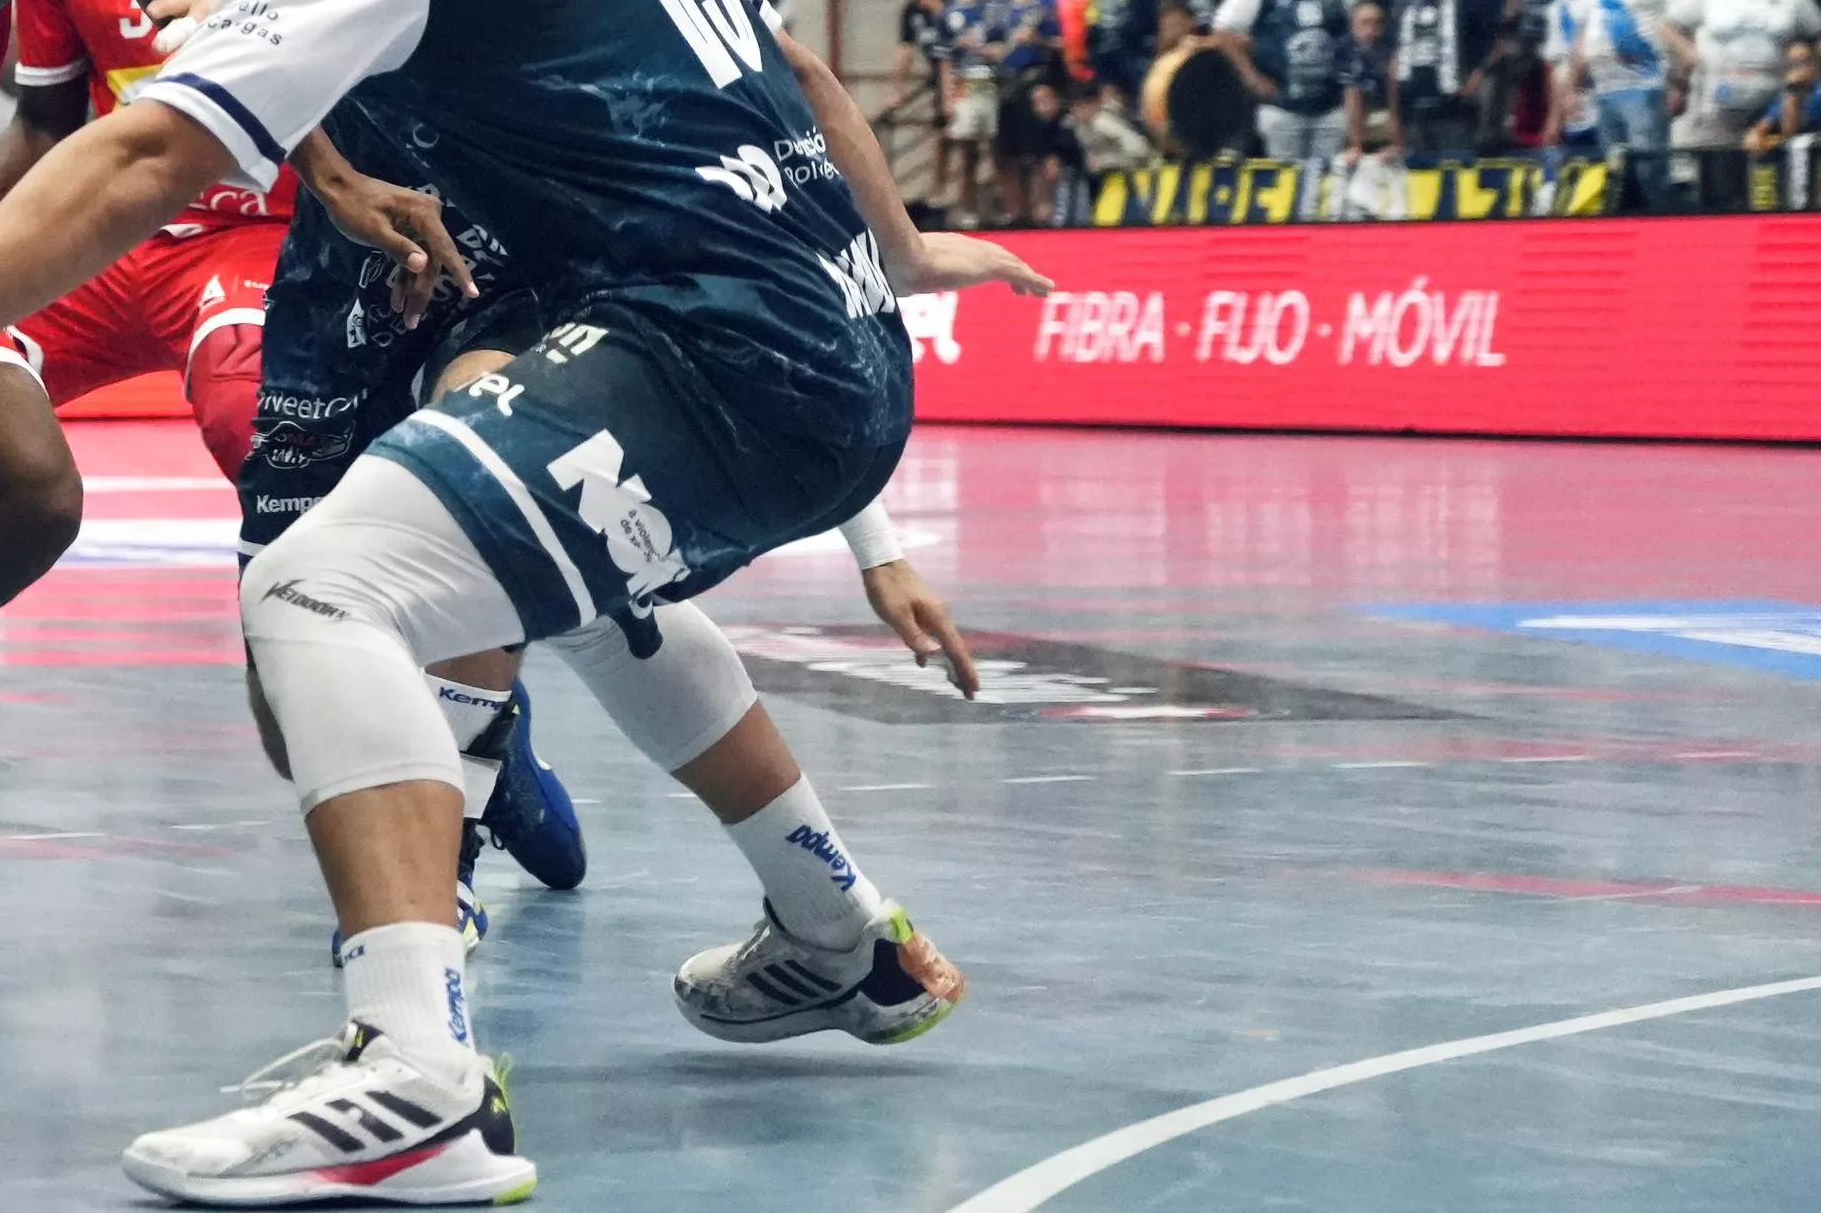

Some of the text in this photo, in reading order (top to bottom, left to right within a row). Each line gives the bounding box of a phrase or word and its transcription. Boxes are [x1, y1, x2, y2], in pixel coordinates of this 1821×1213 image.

[1033, 290, 1166, 365] FIBRA
[1195, 290, 1310, 366] FIJO
[1336, 274, 1507, 368] MÓVIL
[785, 824, 857, 892] Kempa
